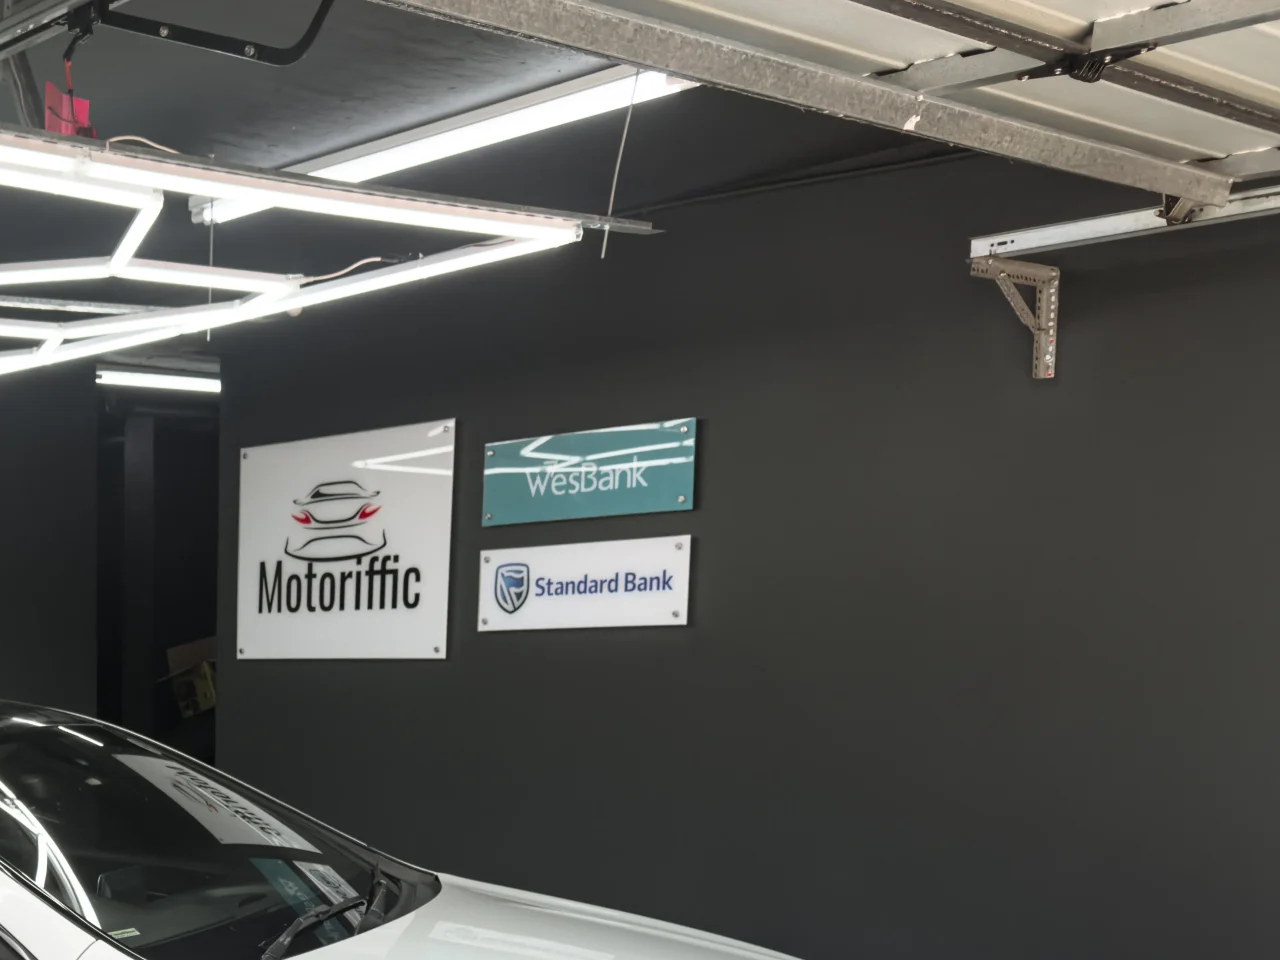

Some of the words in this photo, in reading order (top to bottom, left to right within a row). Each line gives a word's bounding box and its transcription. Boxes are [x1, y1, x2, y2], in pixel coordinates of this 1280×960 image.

[525, 455, 648, 497] WesBank
[258, 555, 421, 614] Motoriffic
[534, 572, 619, 597] Standard
[623, 569, 673, 592] Bank
